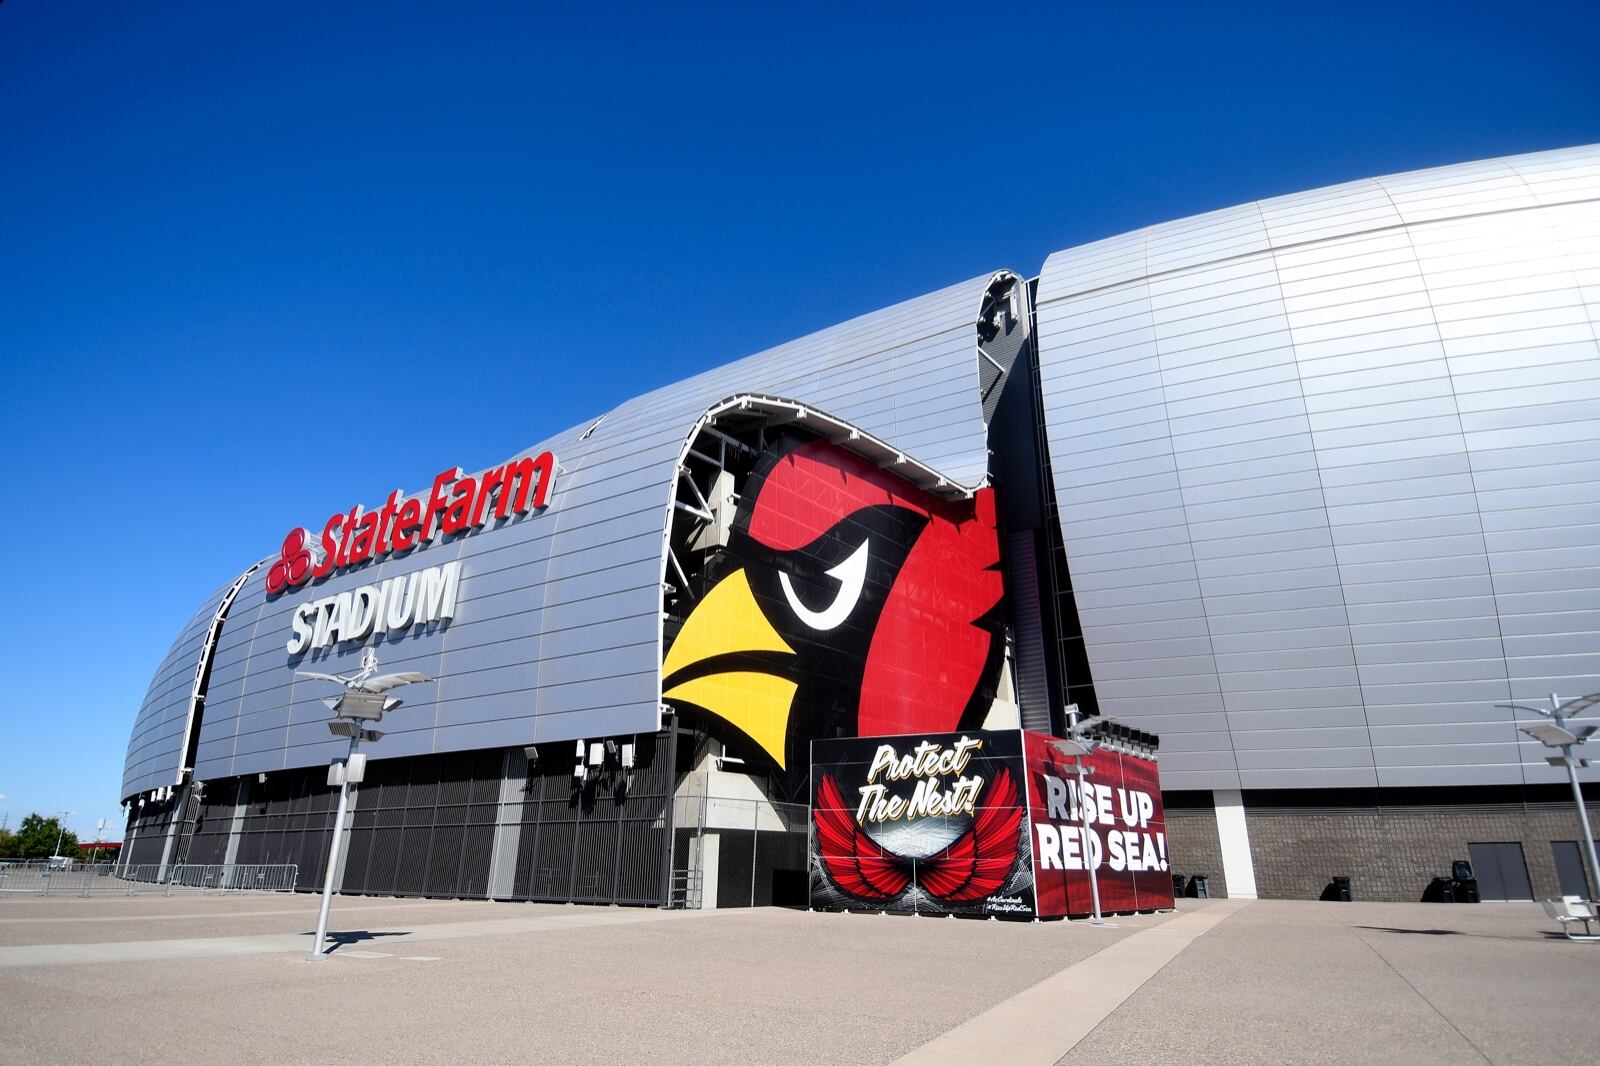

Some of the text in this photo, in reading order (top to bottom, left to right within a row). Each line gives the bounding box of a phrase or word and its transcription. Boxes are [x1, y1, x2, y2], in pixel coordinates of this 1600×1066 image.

[287, 561, 462, 654] STADIUM
[867, 735, 983, 783] Protect
[856, 774, 985, 826] The Nest!
[1044, 774, 1154, 829] RISE UP
[1034, 823, 1169, 872] RED SEA!
